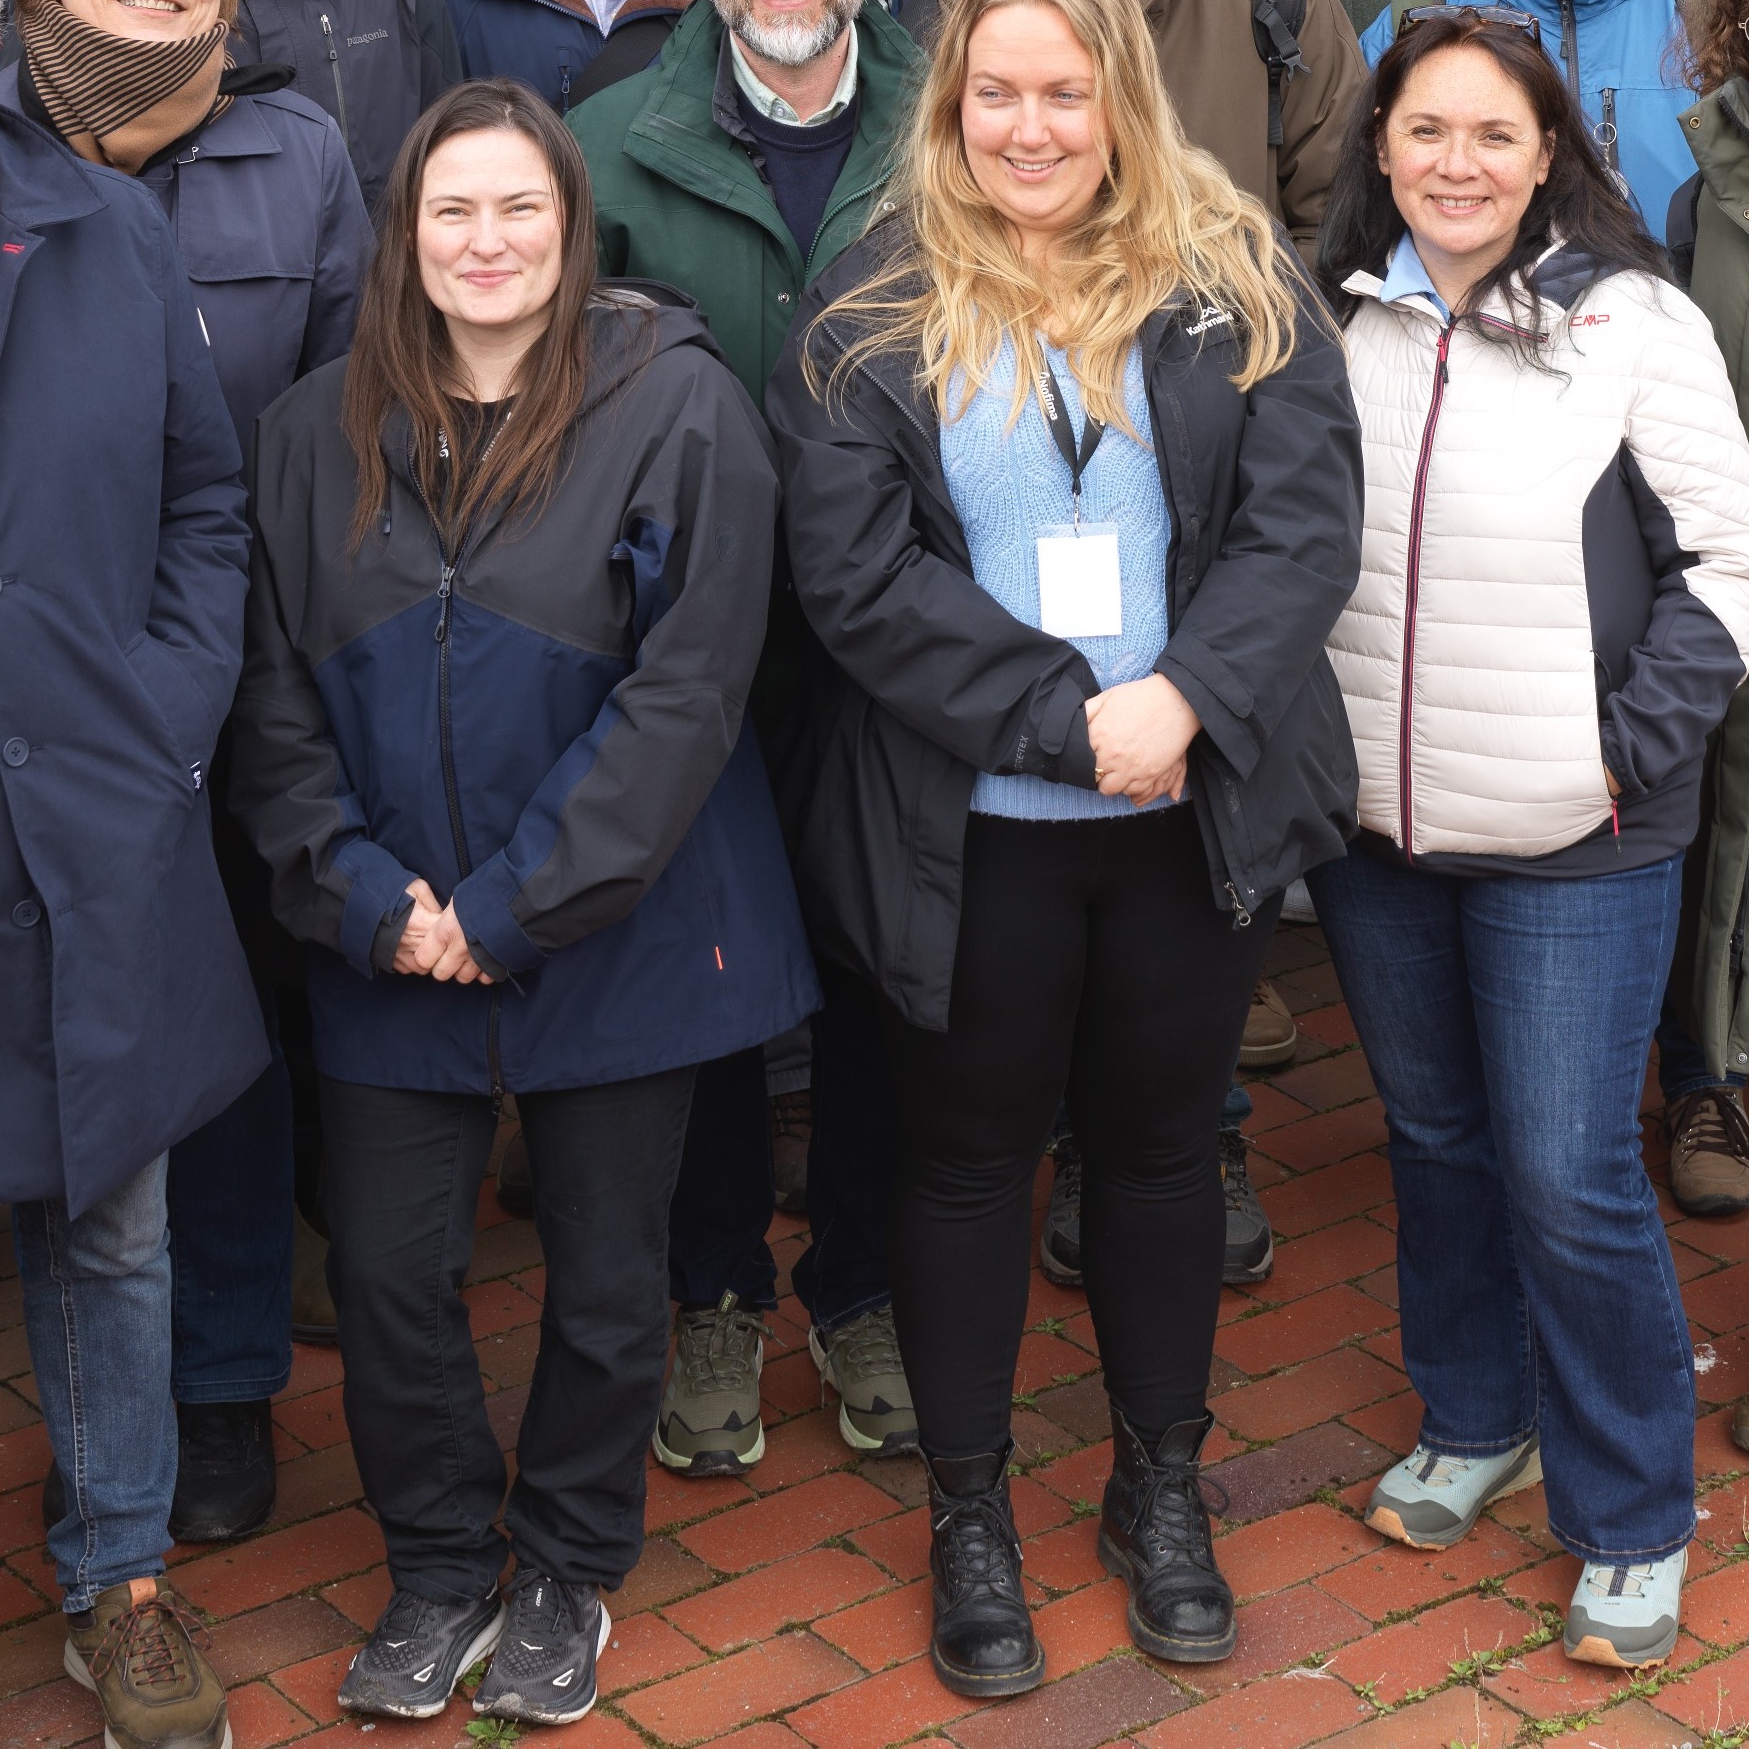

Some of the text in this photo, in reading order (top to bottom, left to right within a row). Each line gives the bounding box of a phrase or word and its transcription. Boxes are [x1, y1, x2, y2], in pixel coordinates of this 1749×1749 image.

[1185, 310, 1235, 337] Kathmand
[1569, 314, 1610, 327] CMP
[1039, 378, 1059, 421] Nofima
